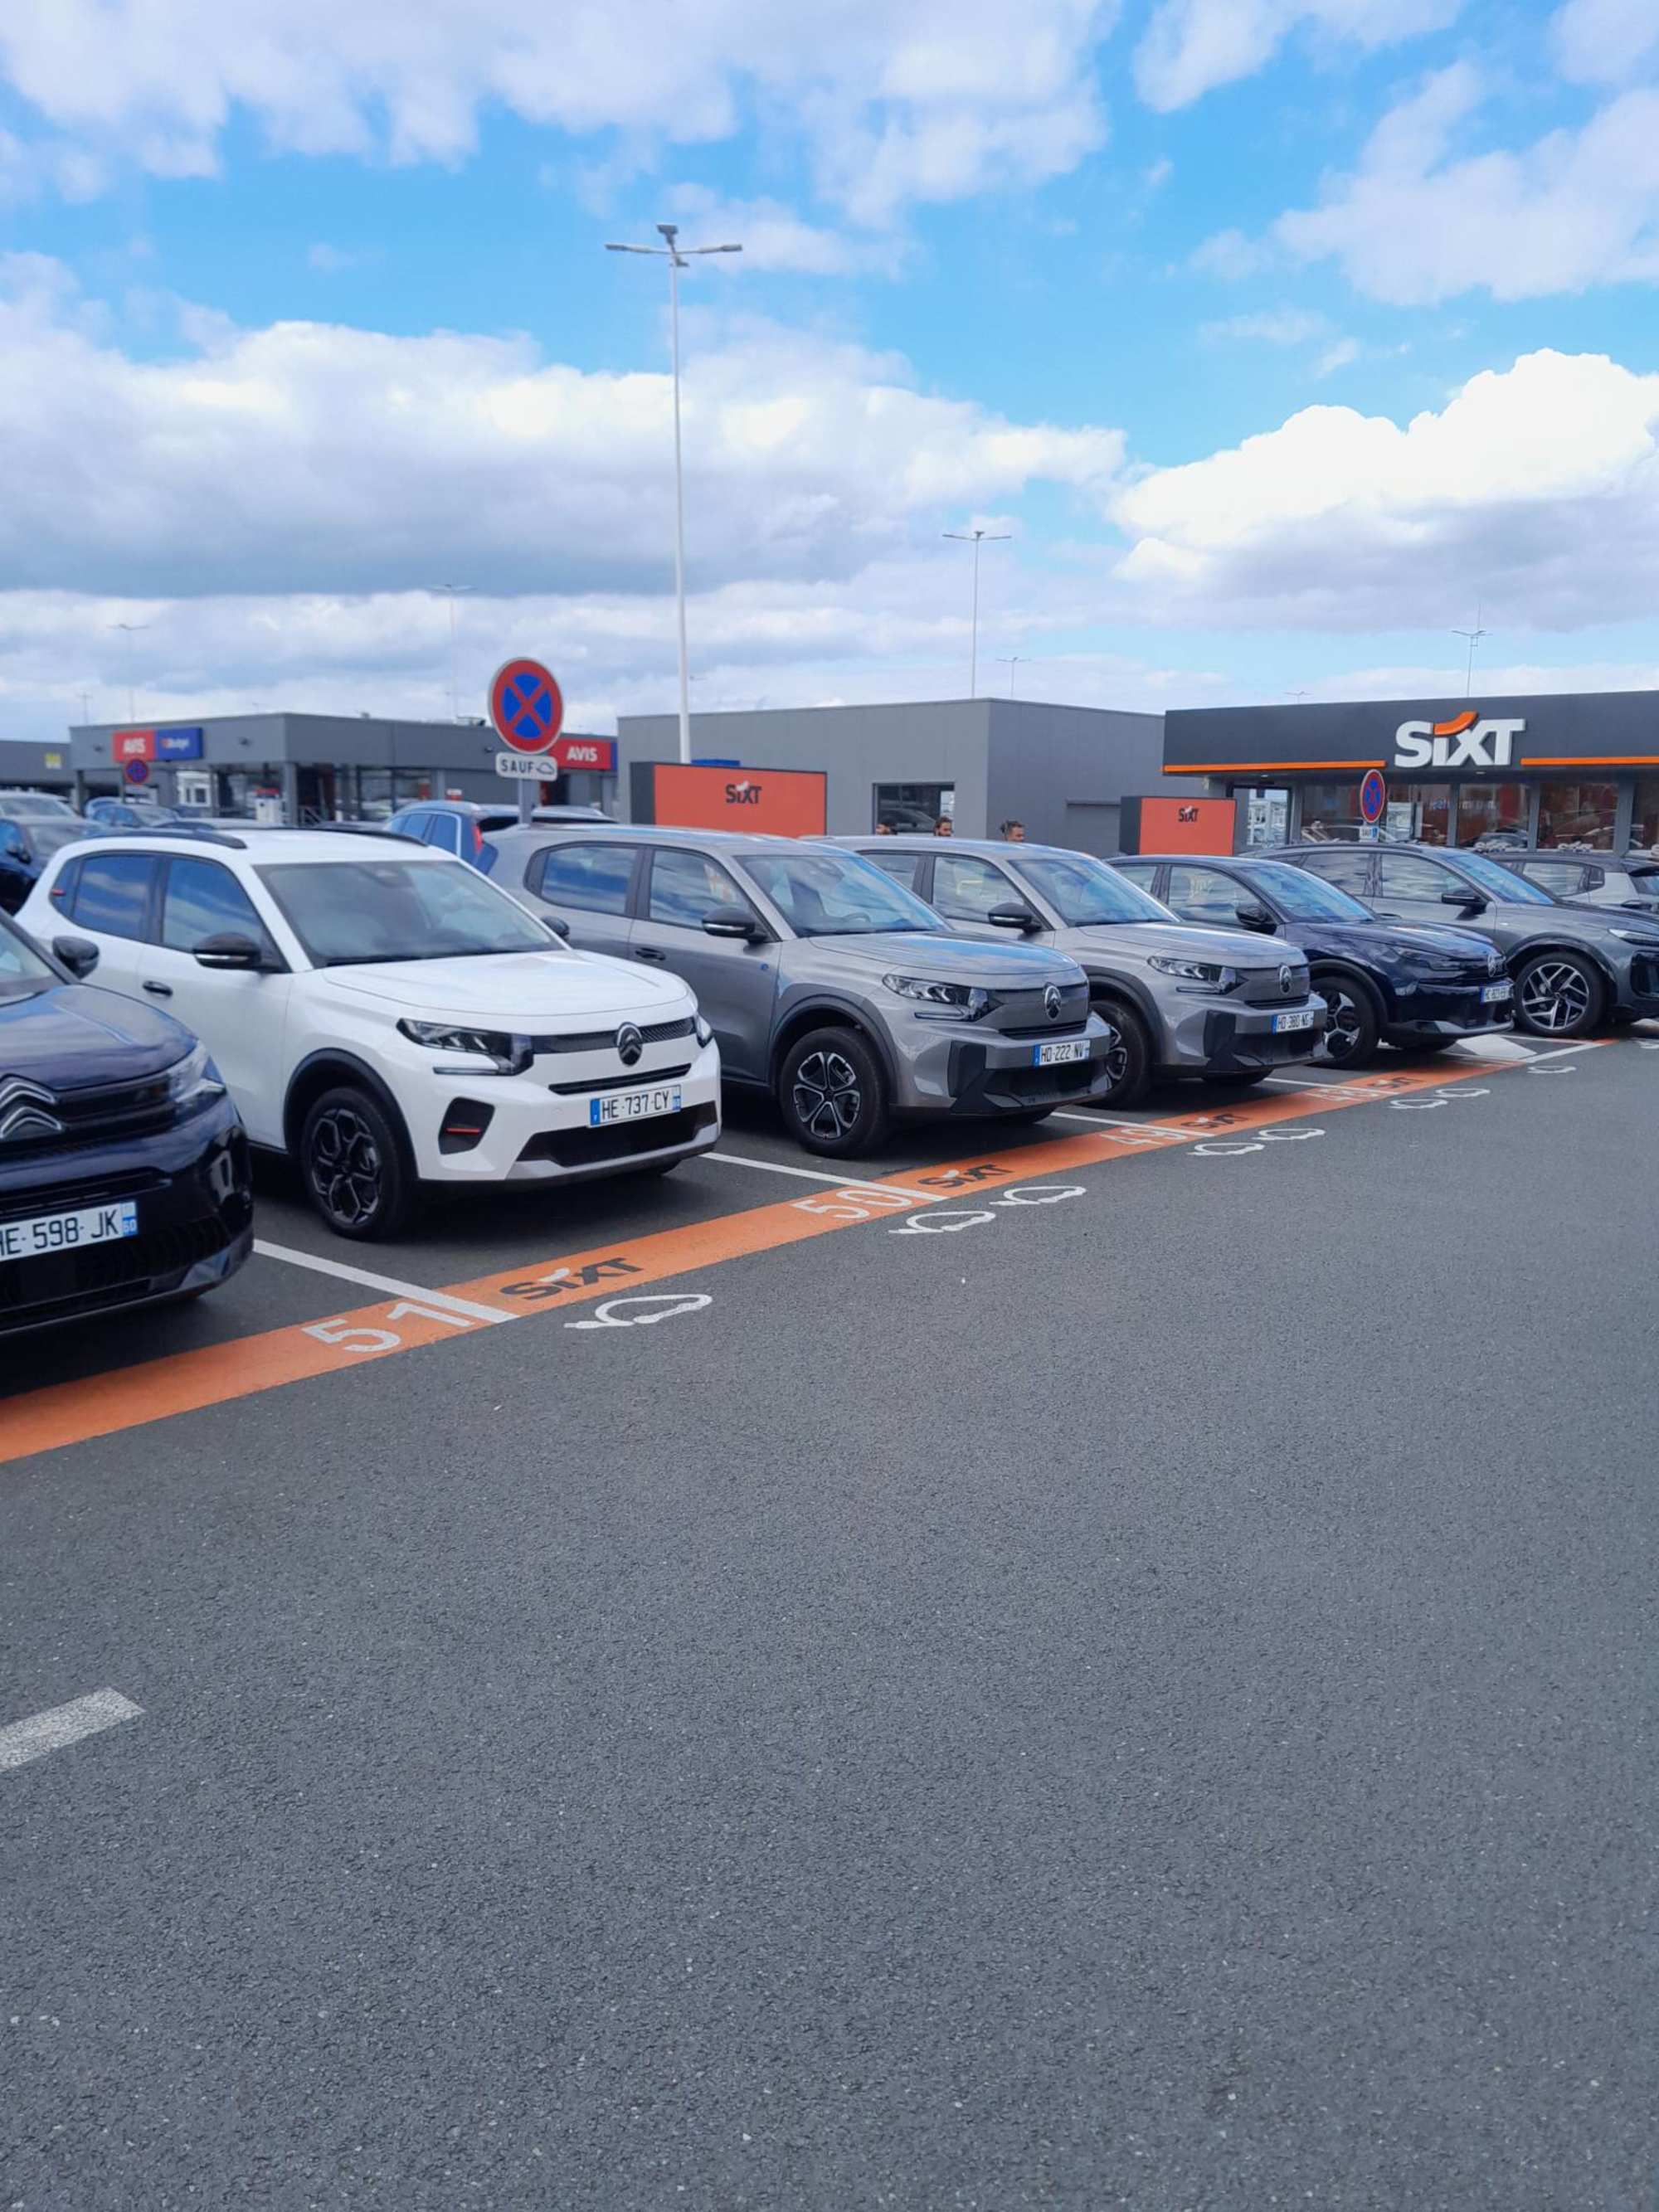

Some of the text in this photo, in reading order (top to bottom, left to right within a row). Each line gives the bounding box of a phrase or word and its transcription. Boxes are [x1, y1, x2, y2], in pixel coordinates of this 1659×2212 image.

[567, 746, 597, 761] AVIS
[501, 759, 533, 773] SAUF
[791, 1190, 912, 1219] 50
[301, 1302, 474, 1353] 51
